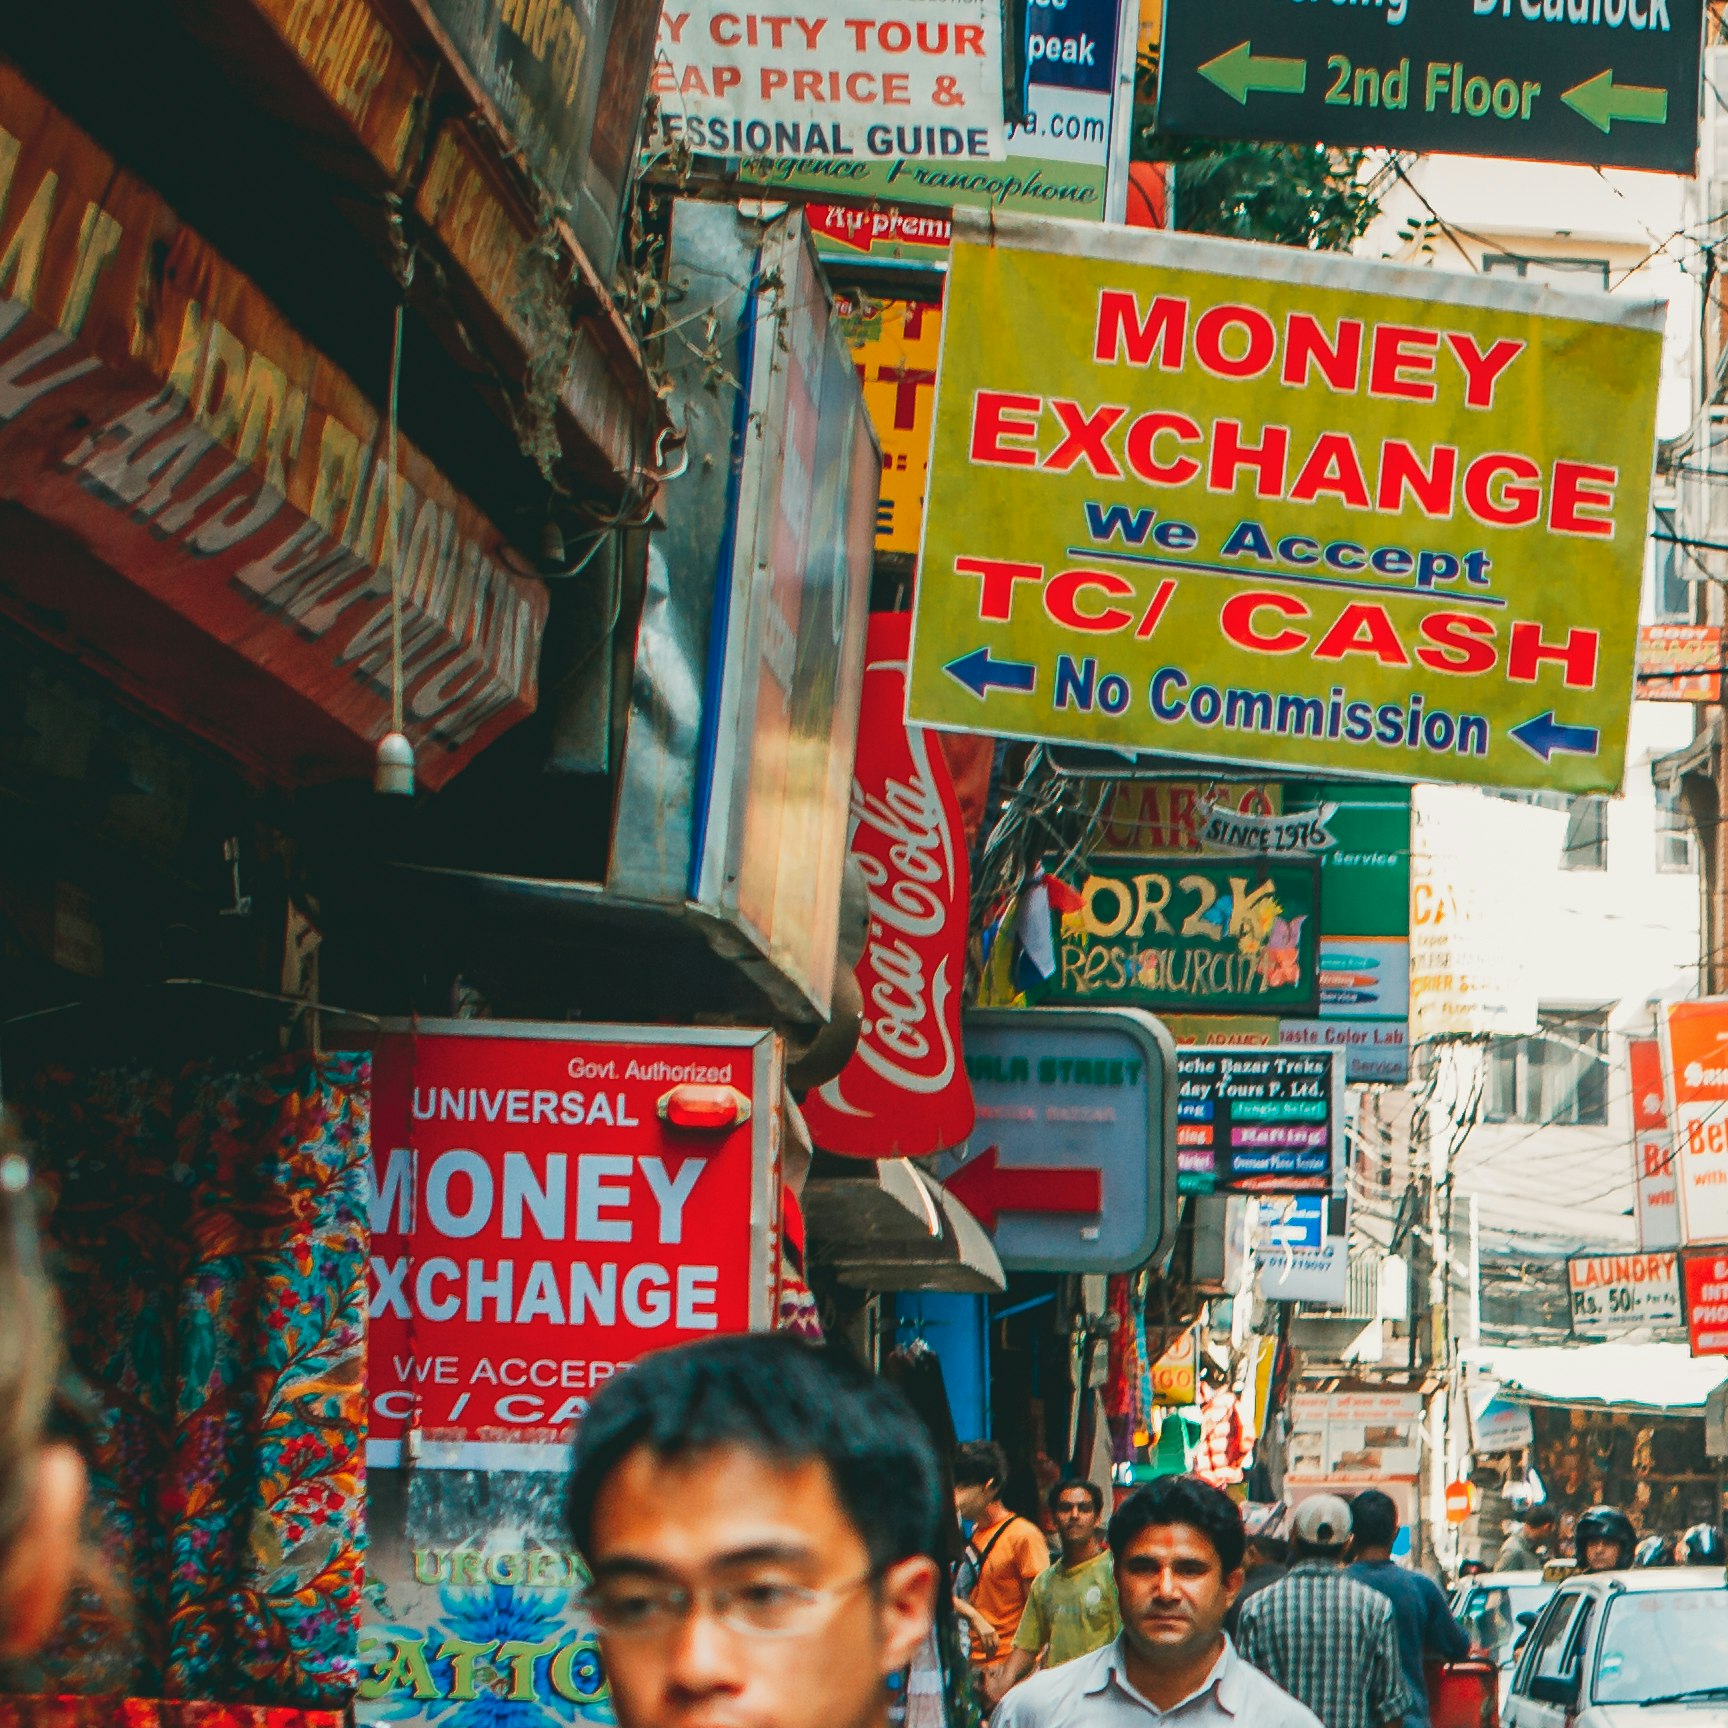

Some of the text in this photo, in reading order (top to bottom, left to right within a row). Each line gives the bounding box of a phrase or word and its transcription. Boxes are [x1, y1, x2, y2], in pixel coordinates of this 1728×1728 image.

[709, 13, 987, 57] CITY TOUR
[1027, 32, 1096, 67] peak
[759, 67, 966, 108] PRICE &
[1325, 54, 1541, 121] 2nd Floor
[866, 122, 991, 158] GUIDE
[1093, 285, 1525, 408] MONEY
[968, 390, 1622, 538] EXCHANGE
[1084, 500, 1492, 587] We Accept
[954, 556, 1178, 642] TC/
[1219, 590, 1598, 690] CASH
[1053, 656, 1488, 755] No Commission
[1206, 816, 1268, 852] SINCE
[850, 768, 955, 1097] Coca-Cola
[1324, 1026, 1405, 1046] Color Lab
[567, 1056, 733, 1083] Govt. Authorized
[1038, 1055, 1143, 1087] STREET
[412, 1086, 640, 1128] UNIVERSAL
[1216, 1080, 1265, 1099] Tours
[369, 1147, 709, 1246] MONEY
[1693, 1168, 1728, 1187] with
[1571, 1254, 1677, 1288] LAUNDRY
[1573, 1290, 1602, 1314] Rs.
[393, 1355, 459, 1386] WE
